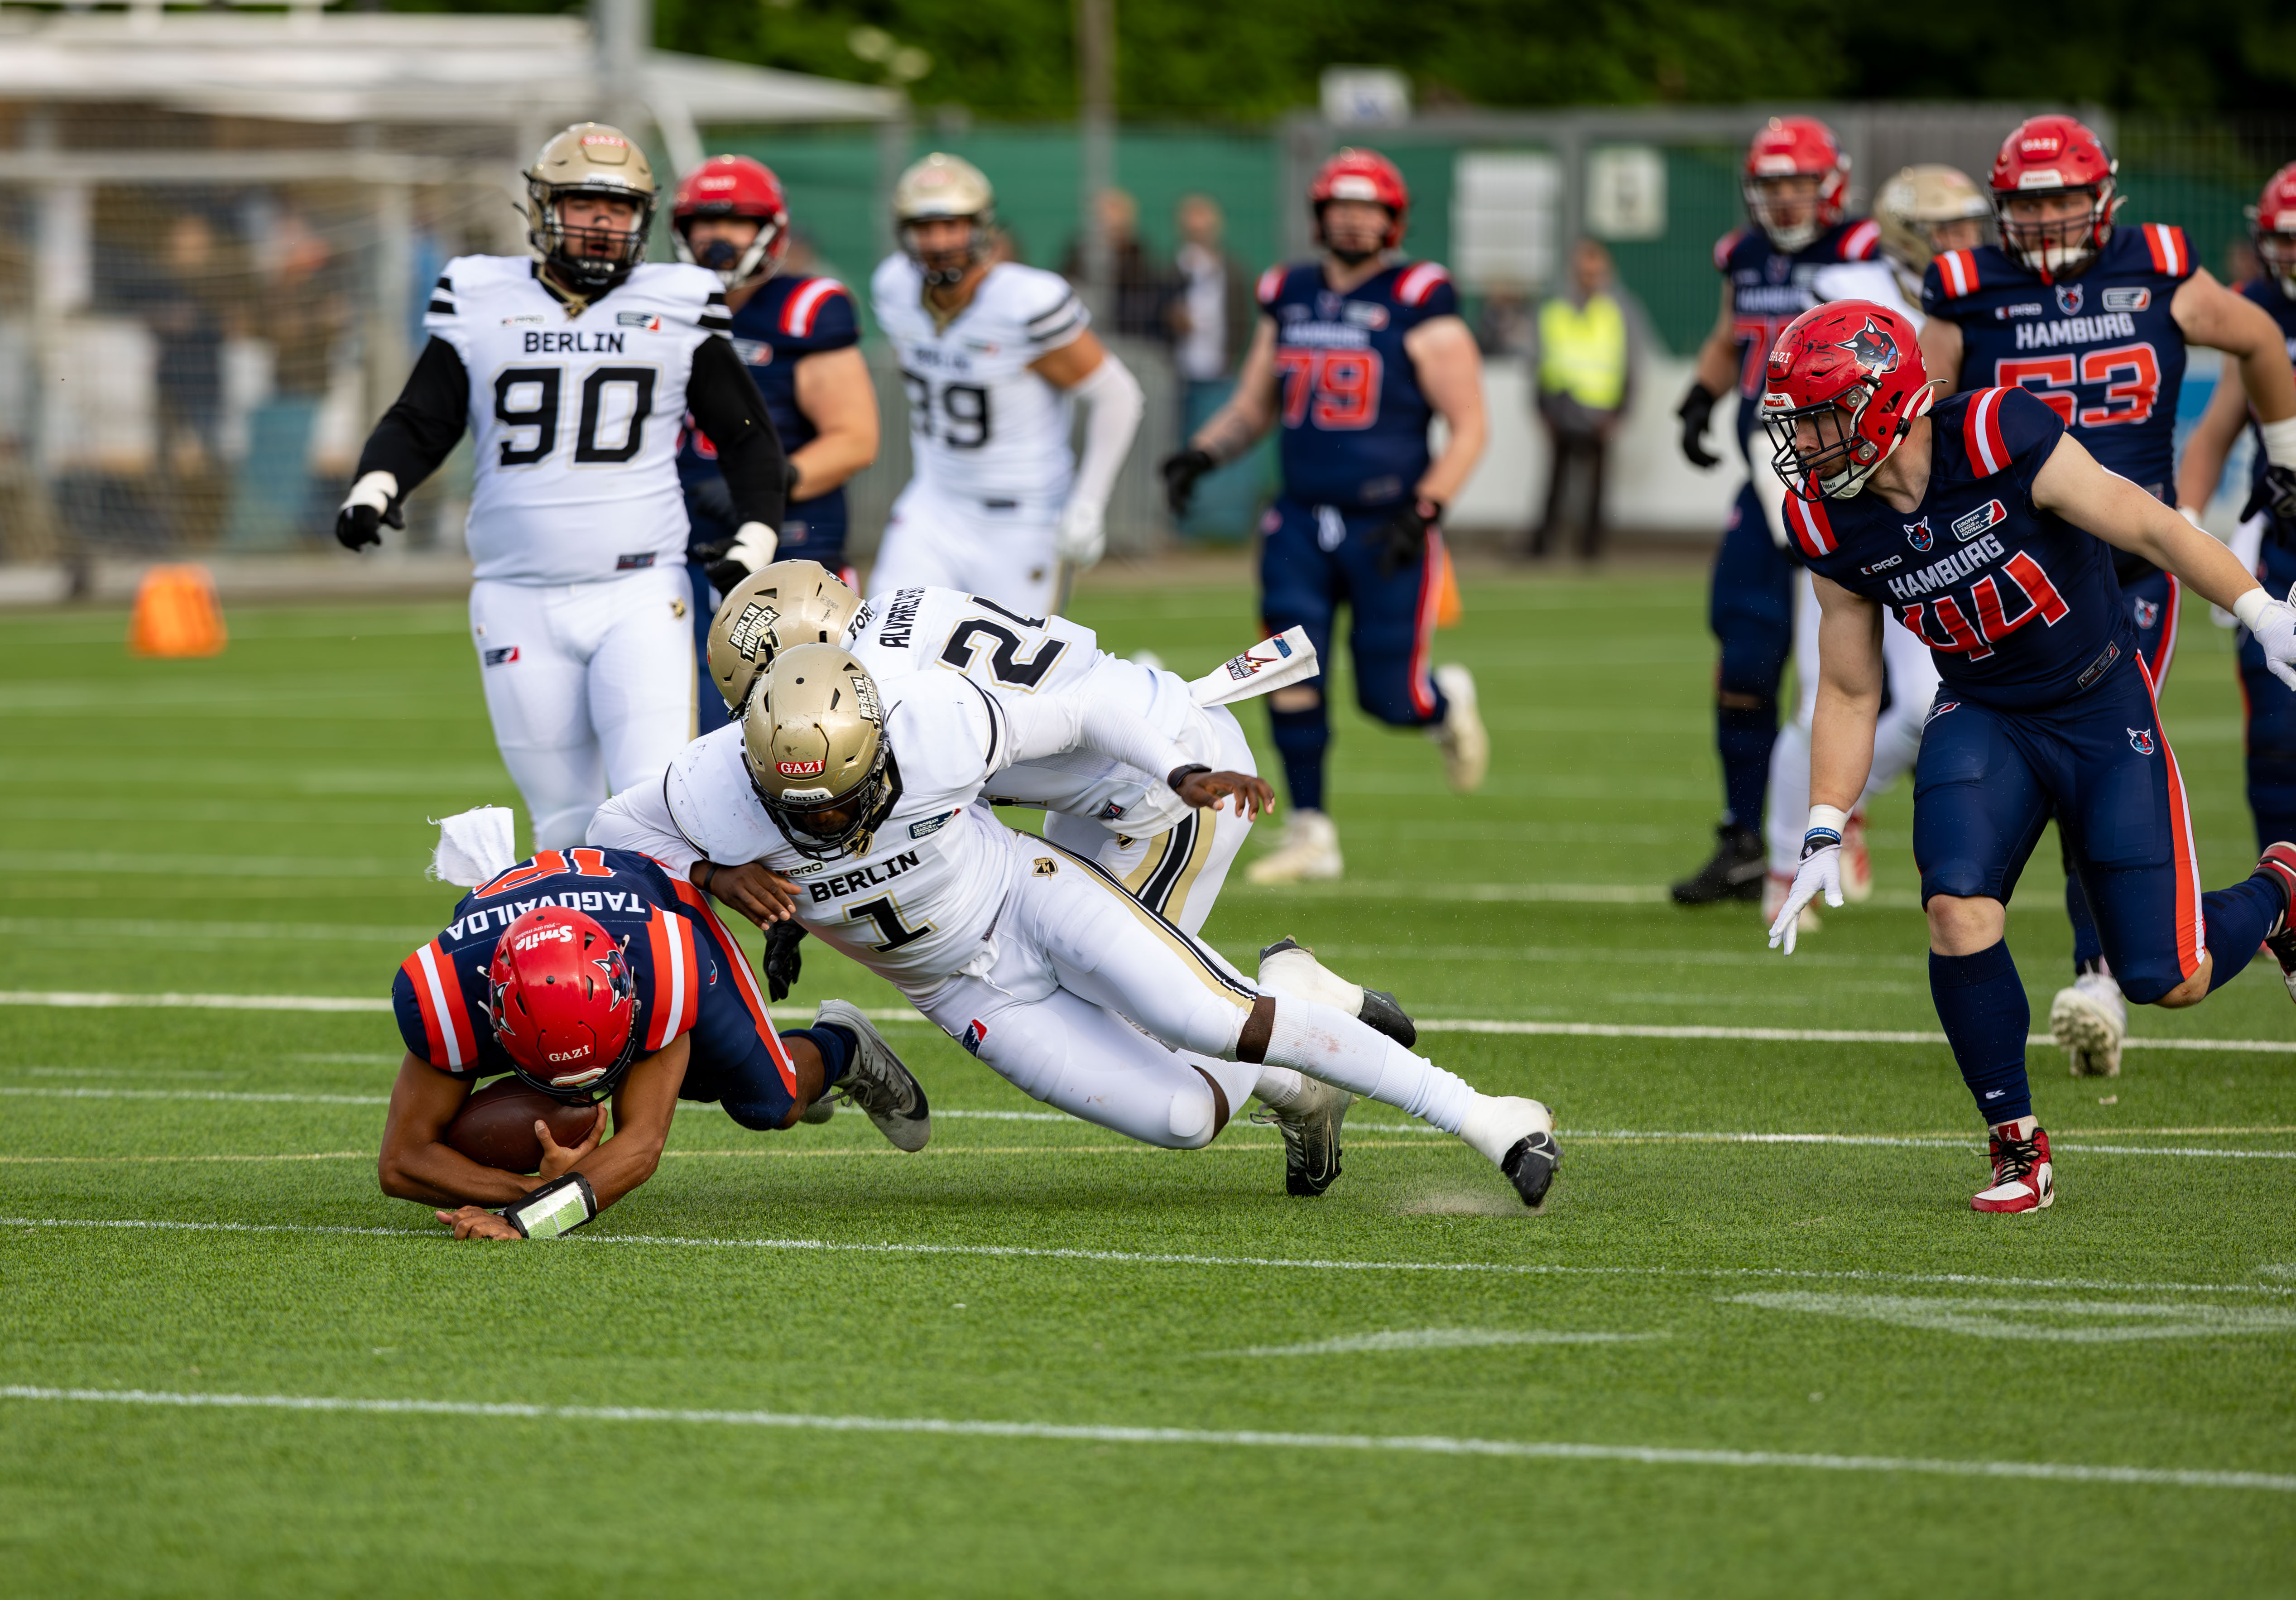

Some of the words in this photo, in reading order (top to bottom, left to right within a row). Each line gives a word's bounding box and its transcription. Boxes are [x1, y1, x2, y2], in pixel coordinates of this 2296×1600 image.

[525, 332, 625, 353] BERLIN
[2016, 312, 2136, 350] HAMBURG
[1274, 346, 1383, 430] 79
[1995, 342, 2161, 428] 53
[491, 364, 660, 469] 90
[1956, 514, 1979, 529] EUROPEAN
[1959, 522, 1976, 533] LEAGUE
[1962, 524, 1984, 537] FOOTBALL
[1888, 533, 2004, 599] HAMBURG
[730, 605, 759, 648] BERLIN
[879, 598, 922, 648] ALVAREZ
[1902, 550, 2070, 662] 44
[742, 609, 778, 659] THUNDER
[854, 678, 874, 719] BERLIN
[913, 818, 938, 829] EUROPEAN
[913, 825, 932, 833] LEAGUE
[914, 826, 939, 837] FOOTBALL
[808, 850, 921, 903] BERLIN
[446, 892, 646, 941] TAGOVAILOA
[516, 925, 572, 951] Smile
[846, 894, 935, 953] 1
